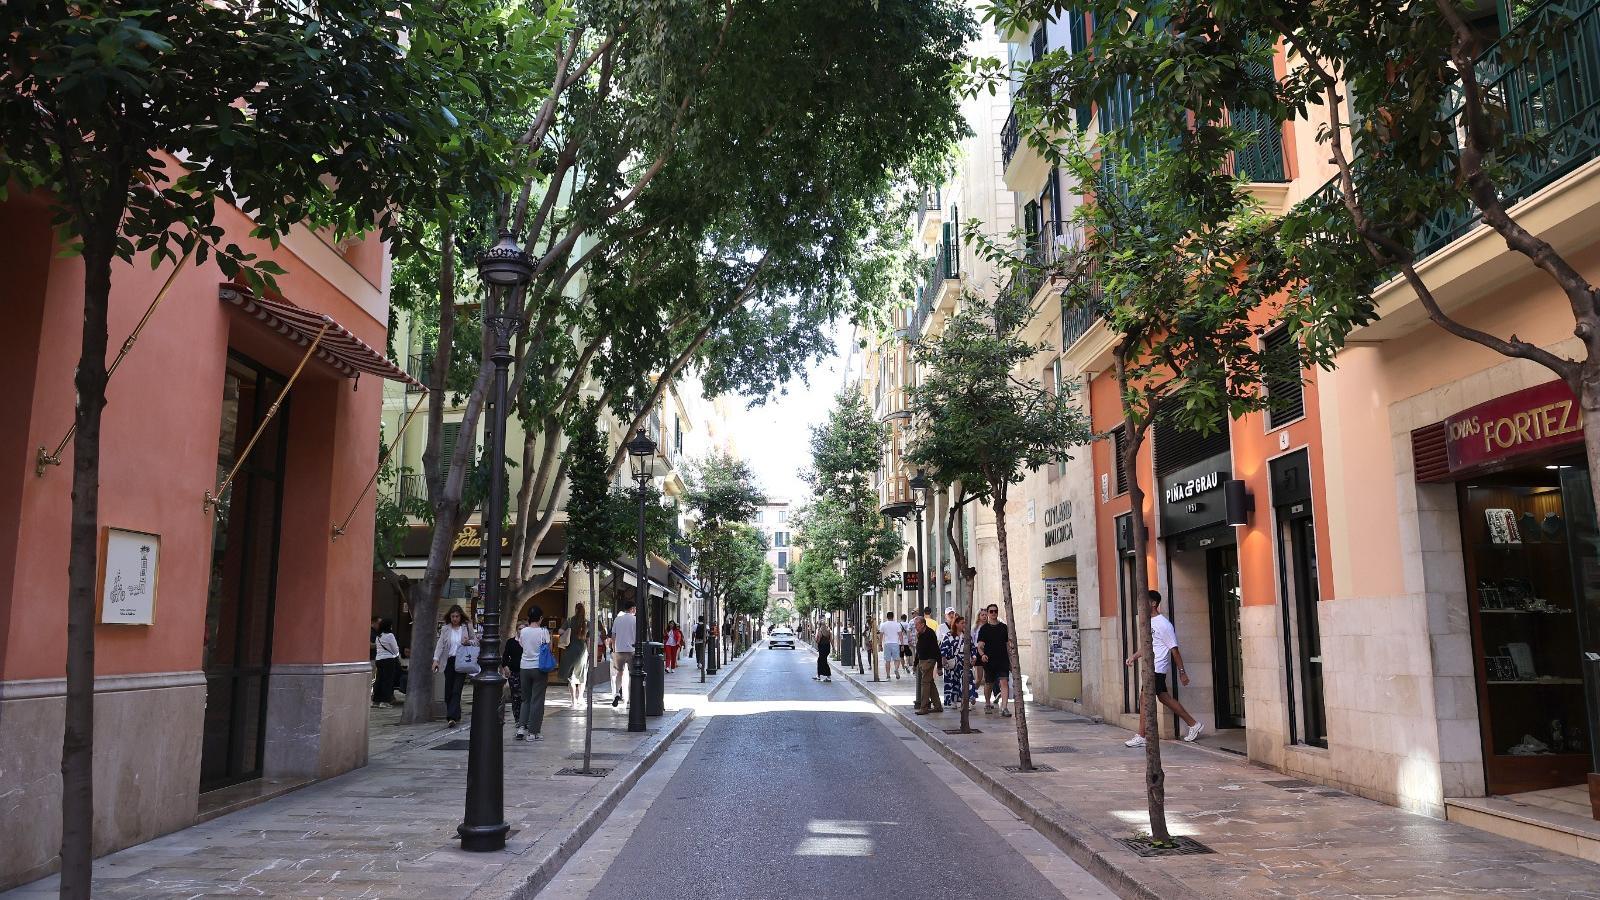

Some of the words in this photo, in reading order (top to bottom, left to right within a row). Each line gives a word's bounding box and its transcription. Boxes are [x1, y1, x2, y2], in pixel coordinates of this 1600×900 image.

[1448, 415, 1481, 442] JOYAS
[1166, 483, 1184, 504] PIÑA
[1195, 471, 1218, 493] GRAU
